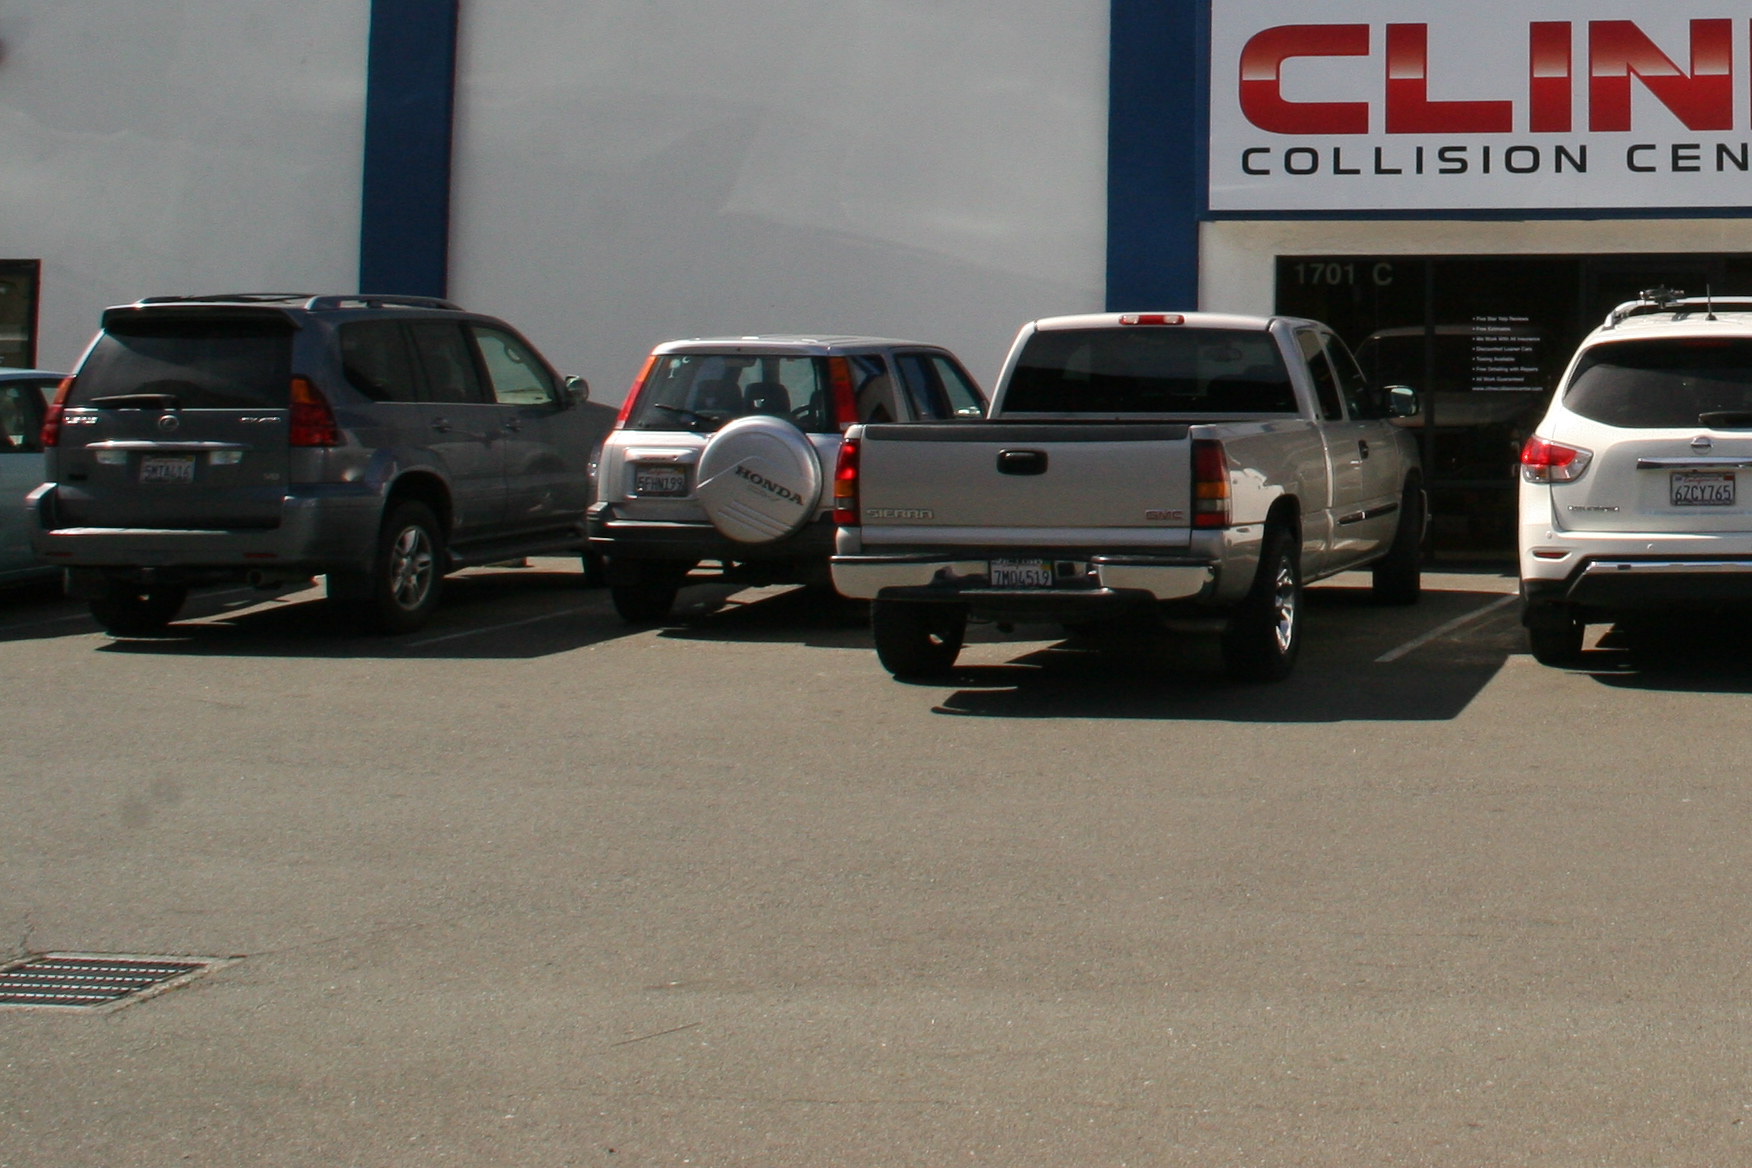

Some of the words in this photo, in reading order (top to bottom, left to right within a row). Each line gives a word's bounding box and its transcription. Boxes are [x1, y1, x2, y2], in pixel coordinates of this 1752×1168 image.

[1241, 144, 1588, 175] COLLISION
[1293, 262, 1355, 285] 1701
[1372, 262, 1394, 286] C
[735, 465, 803, 506] HONDA
[1675, 485, 1731, 501] 6ZCY765
[866, 508, 934, 519] SIERRA
[1145, 509, 1184, 520] GMC
